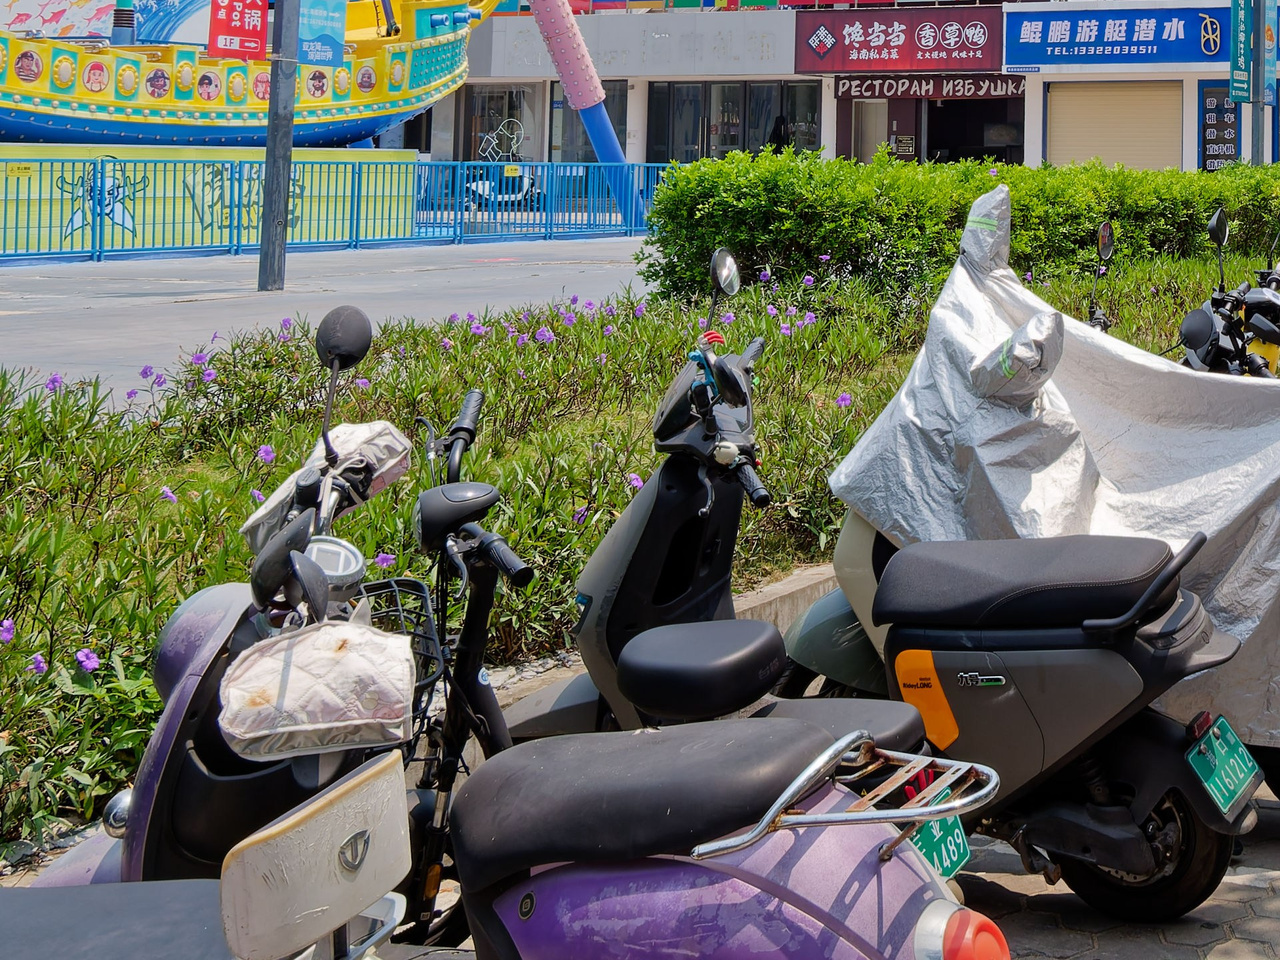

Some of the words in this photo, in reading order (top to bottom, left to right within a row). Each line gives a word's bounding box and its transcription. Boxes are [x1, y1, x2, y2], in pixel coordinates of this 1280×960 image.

[231, 2, 242, 27] Pot
[842, 21, 906, 48] 馋当当
[1020, 18, 1186, 43] 鲲鹏游艇潜水
[224, 37, 235, 47] 1F
[1046, 46, 1157, 55] TEL:13322039511
[849, 48, 900, 60] 海南私房菜
[838, 79, 934, 97] РЕСТОРАН
[942, 79, 1026, 97] ИЗБУШКА
[1206, 143, 1235, 155] 直升机
[1210, 747, 1253, 803] 1161212
